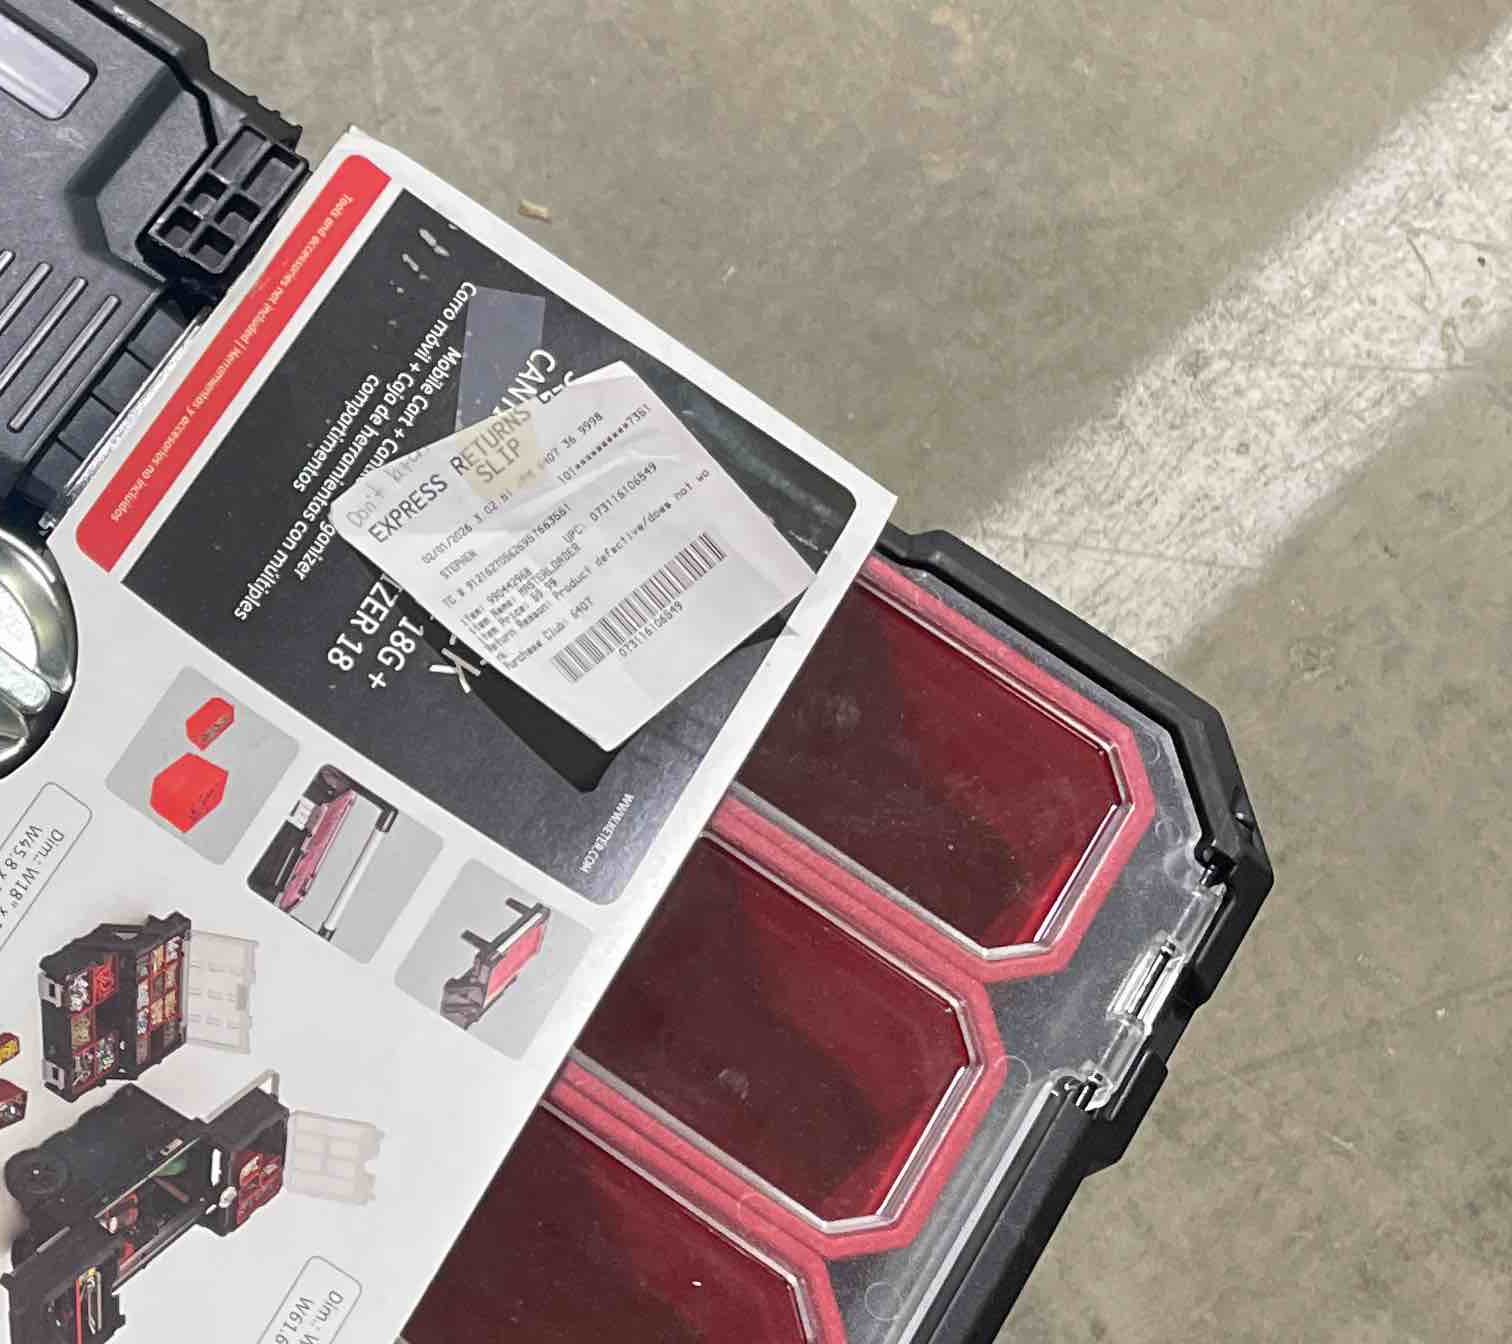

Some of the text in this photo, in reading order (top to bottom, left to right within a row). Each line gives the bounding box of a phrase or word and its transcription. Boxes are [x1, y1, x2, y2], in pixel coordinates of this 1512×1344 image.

[314, 215, 336, 239] and
[328, 191, 354, 220] Tools
[277, 233, 323, 290] accessories
[237, 300, 275, 345] included
[418, 345, 463, 398] Mobile
[287, 369, 384, 496] compartimentos
[389, 425, 404, 440] +
[396, 391, 430, 430] Cart
[227, 278, 478, 625] Carro móvil + Caja de herramientas con múltiples
[367, 399, 534, 545] EXPRESS RETURNS
[473, 434, 528, 485] SLIP
[286, 519, 341, 584] ganizer
[322, 629, 366, 674] 18
[361, 613, 428, 694] 18G +
[1, 821, 43, 872] W45.8
[577, 791, 635, 875] WWW.KETER.COM
